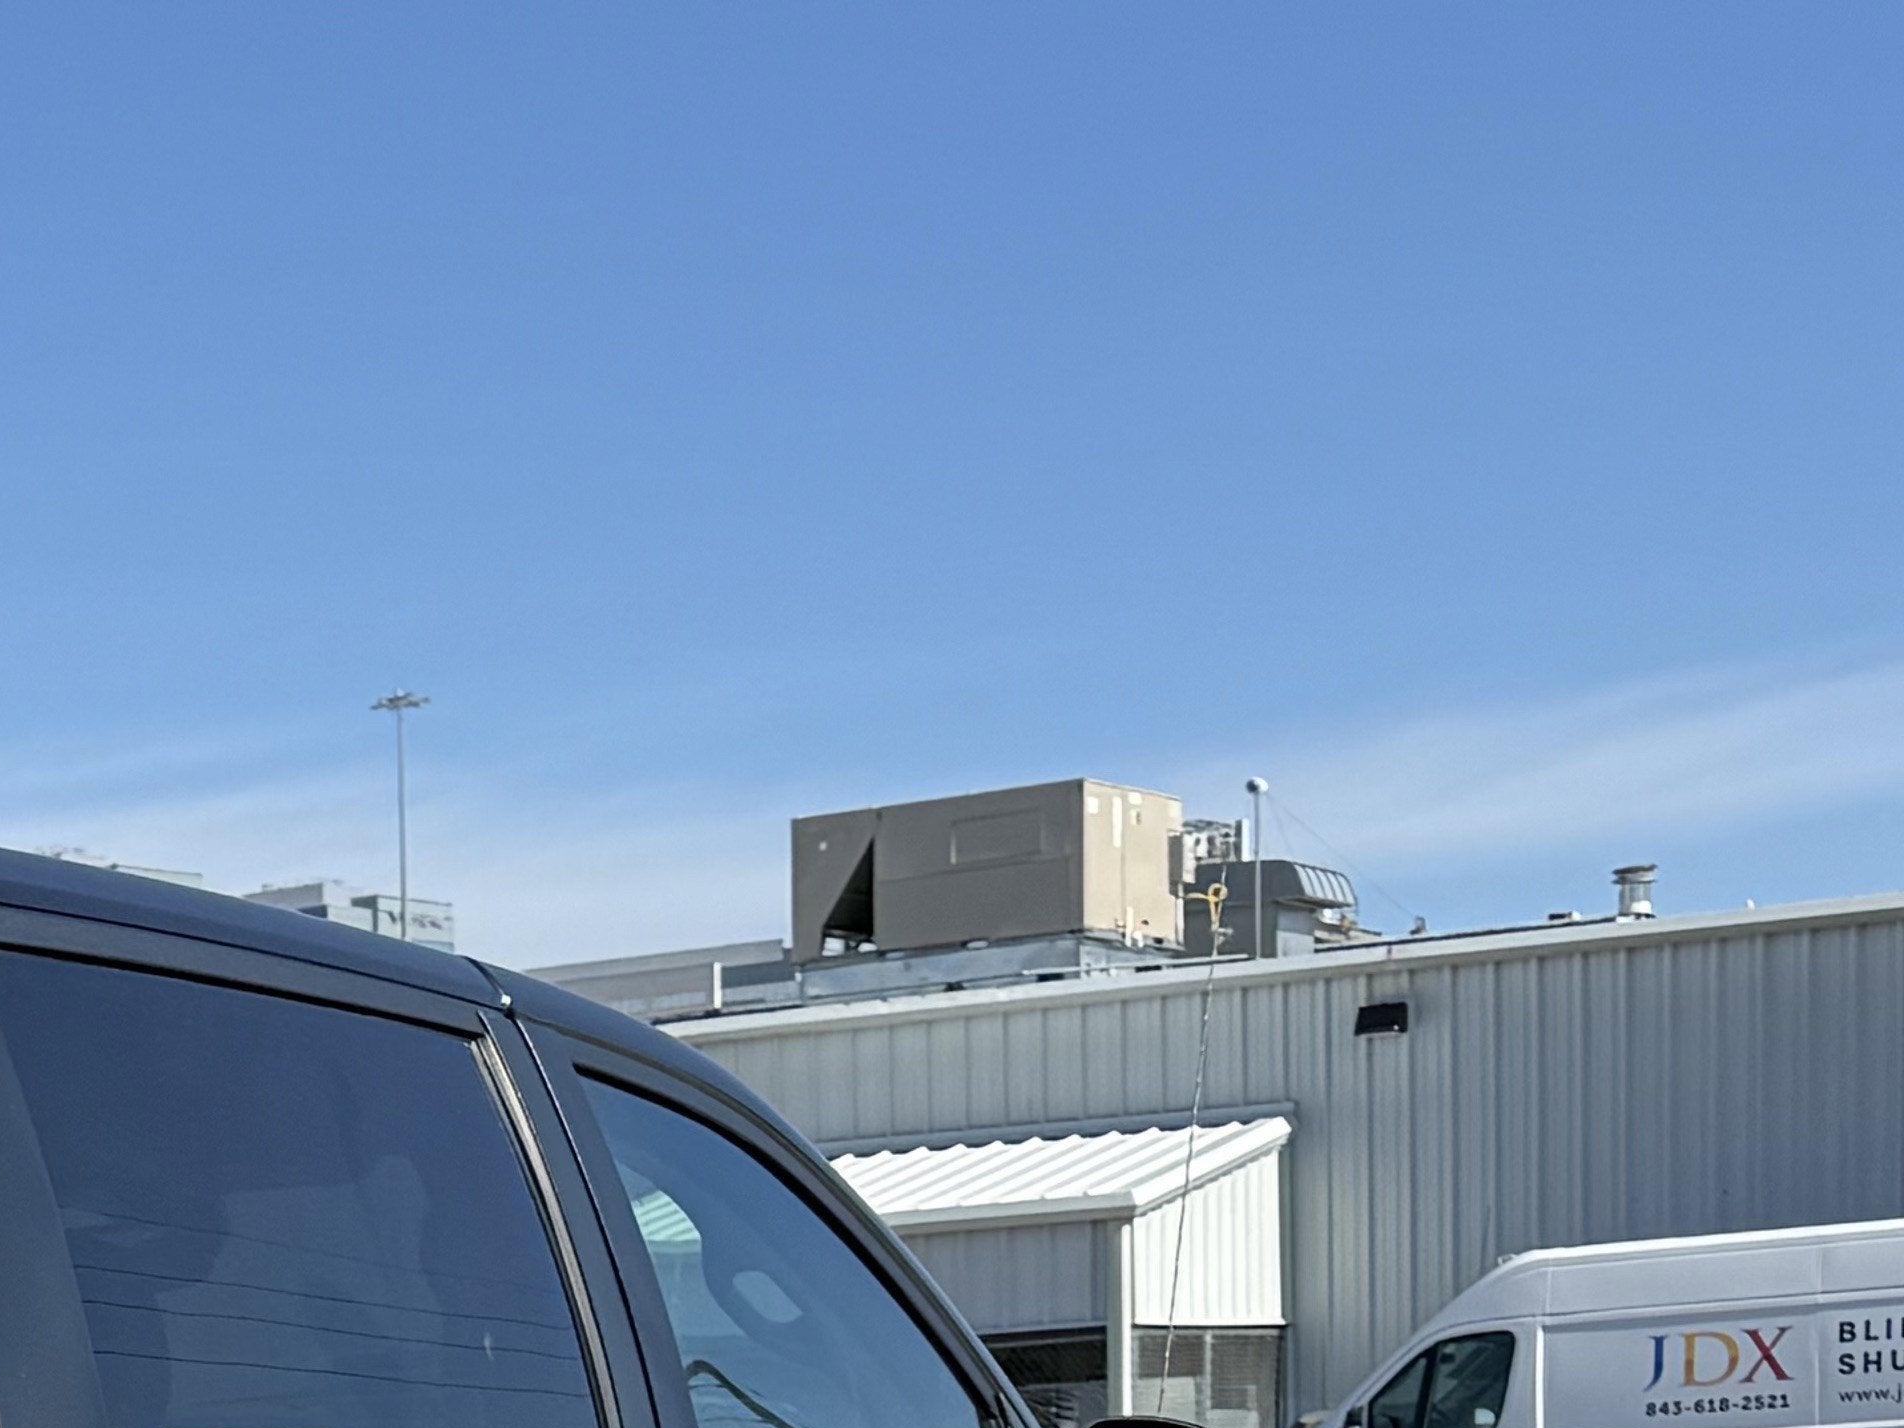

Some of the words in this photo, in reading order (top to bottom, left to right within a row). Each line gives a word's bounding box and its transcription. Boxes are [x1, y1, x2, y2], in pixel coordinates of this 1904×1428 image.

[1838, 1316, 1904, 1343] BLI
[1642, 1325, 1793, 1393] JDX
[1645, 1393, 1791, 1418] 843-618-2521
